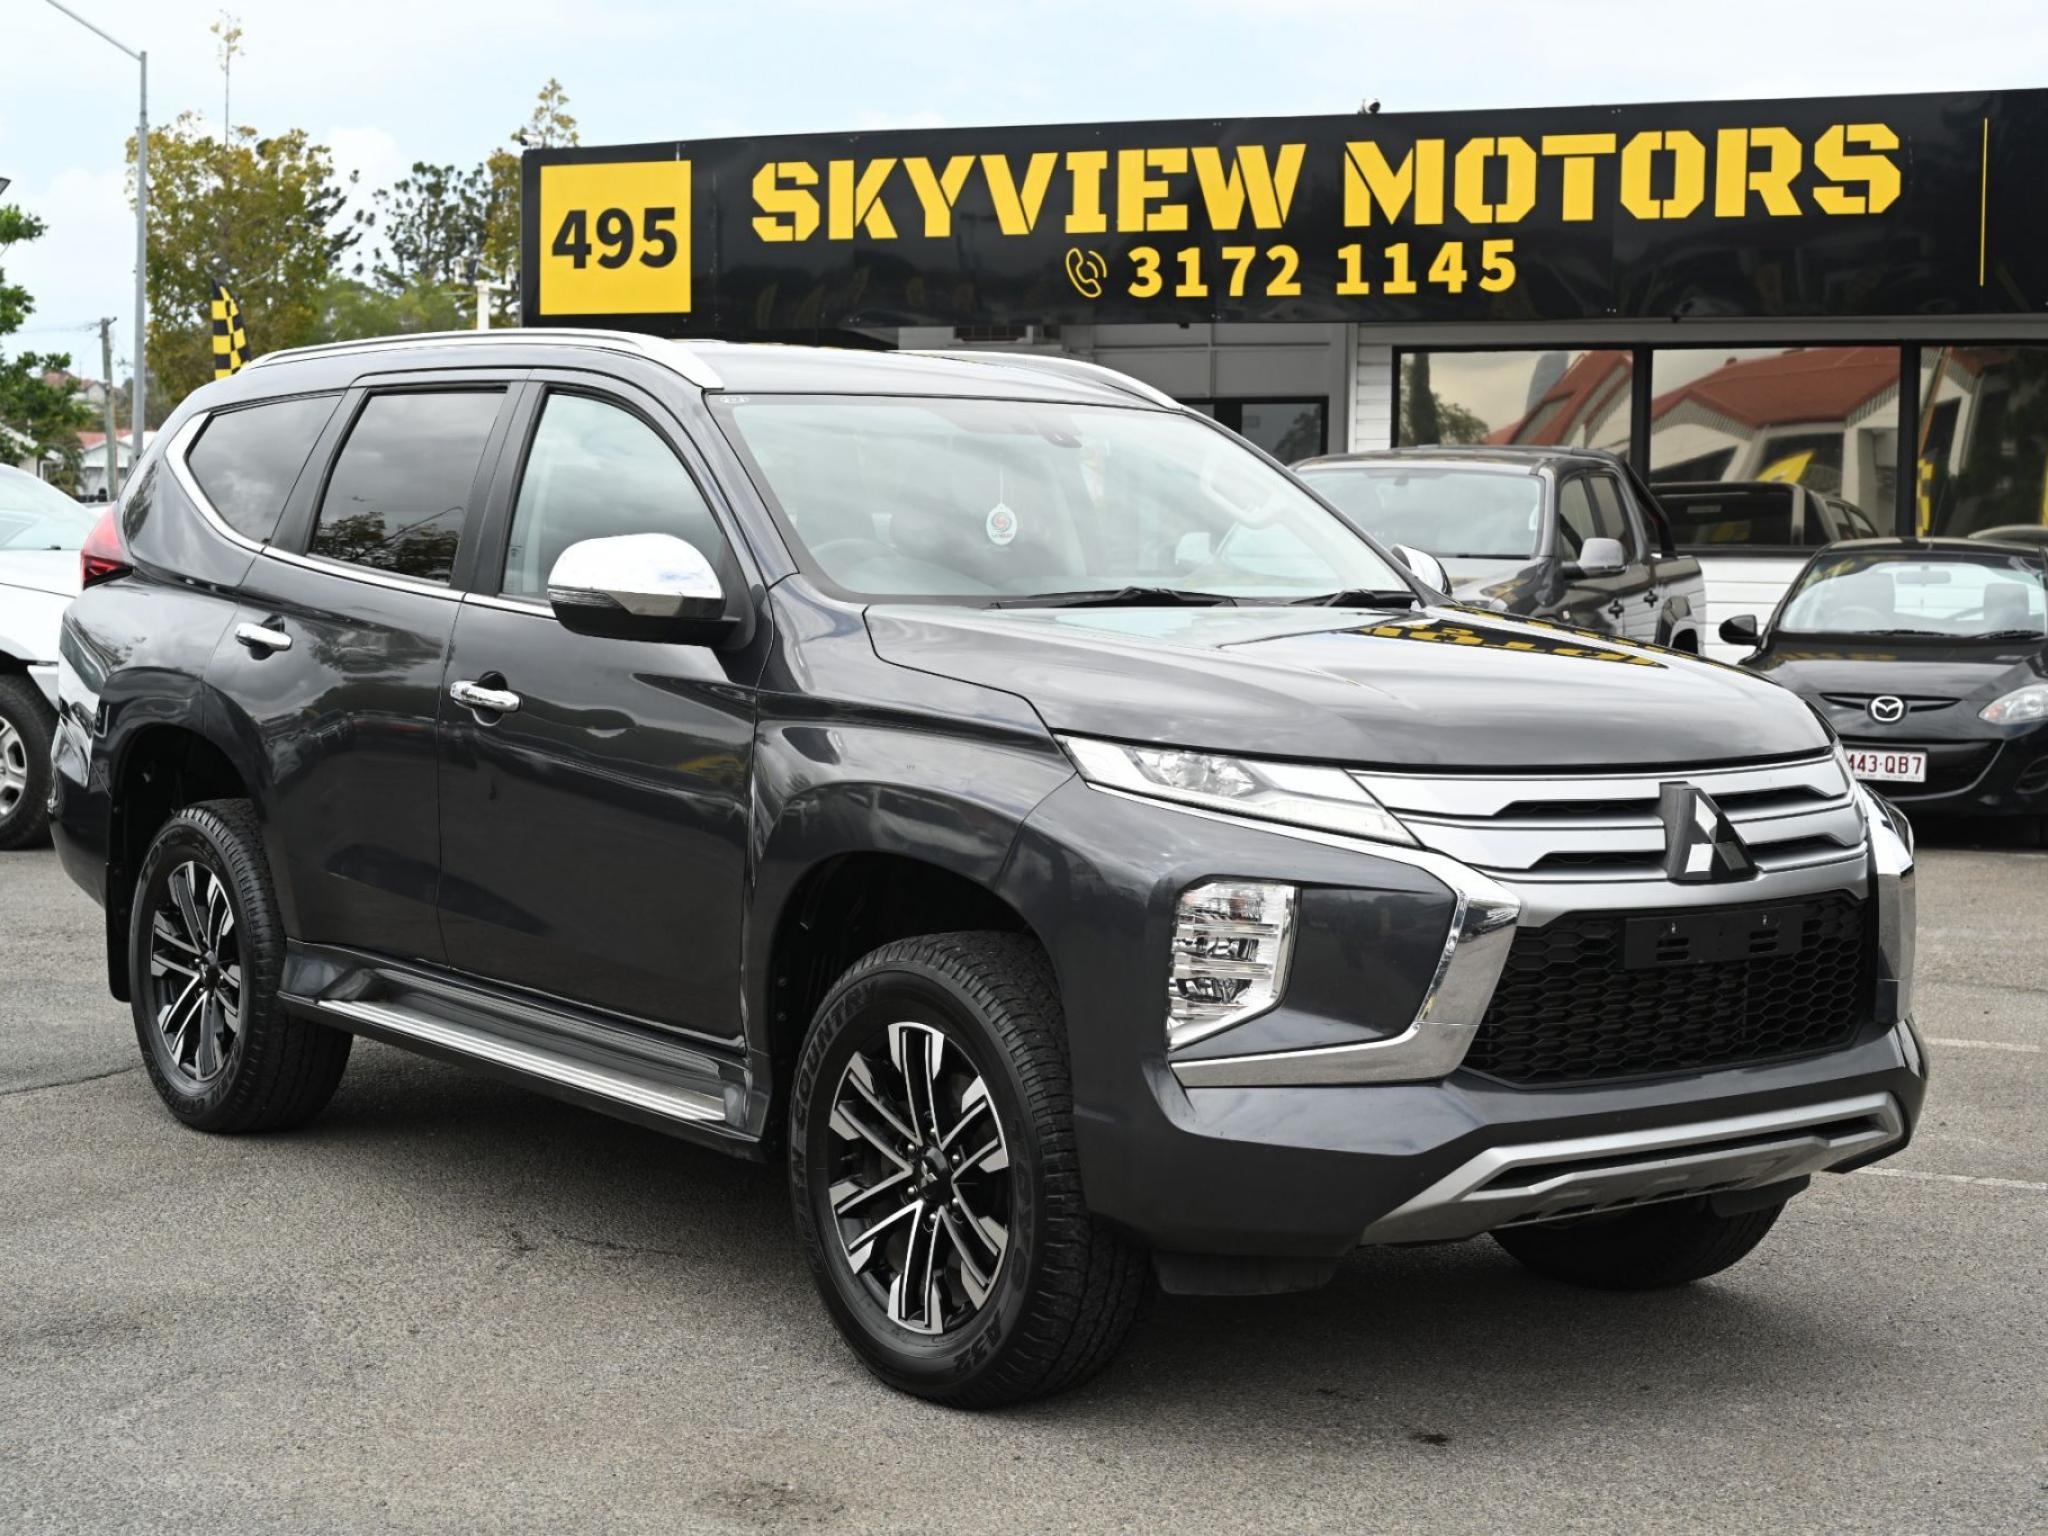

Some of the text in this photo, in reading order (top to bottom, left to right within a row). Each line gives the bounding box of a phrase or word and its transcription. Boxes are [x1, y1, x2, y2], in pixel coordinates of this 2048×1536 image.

[753, 124, 1902, 243] SKYVIEW MOTORS
[552, 206, 678, 270] 495
[1128, 238, 1517, 299] 3172 1145
